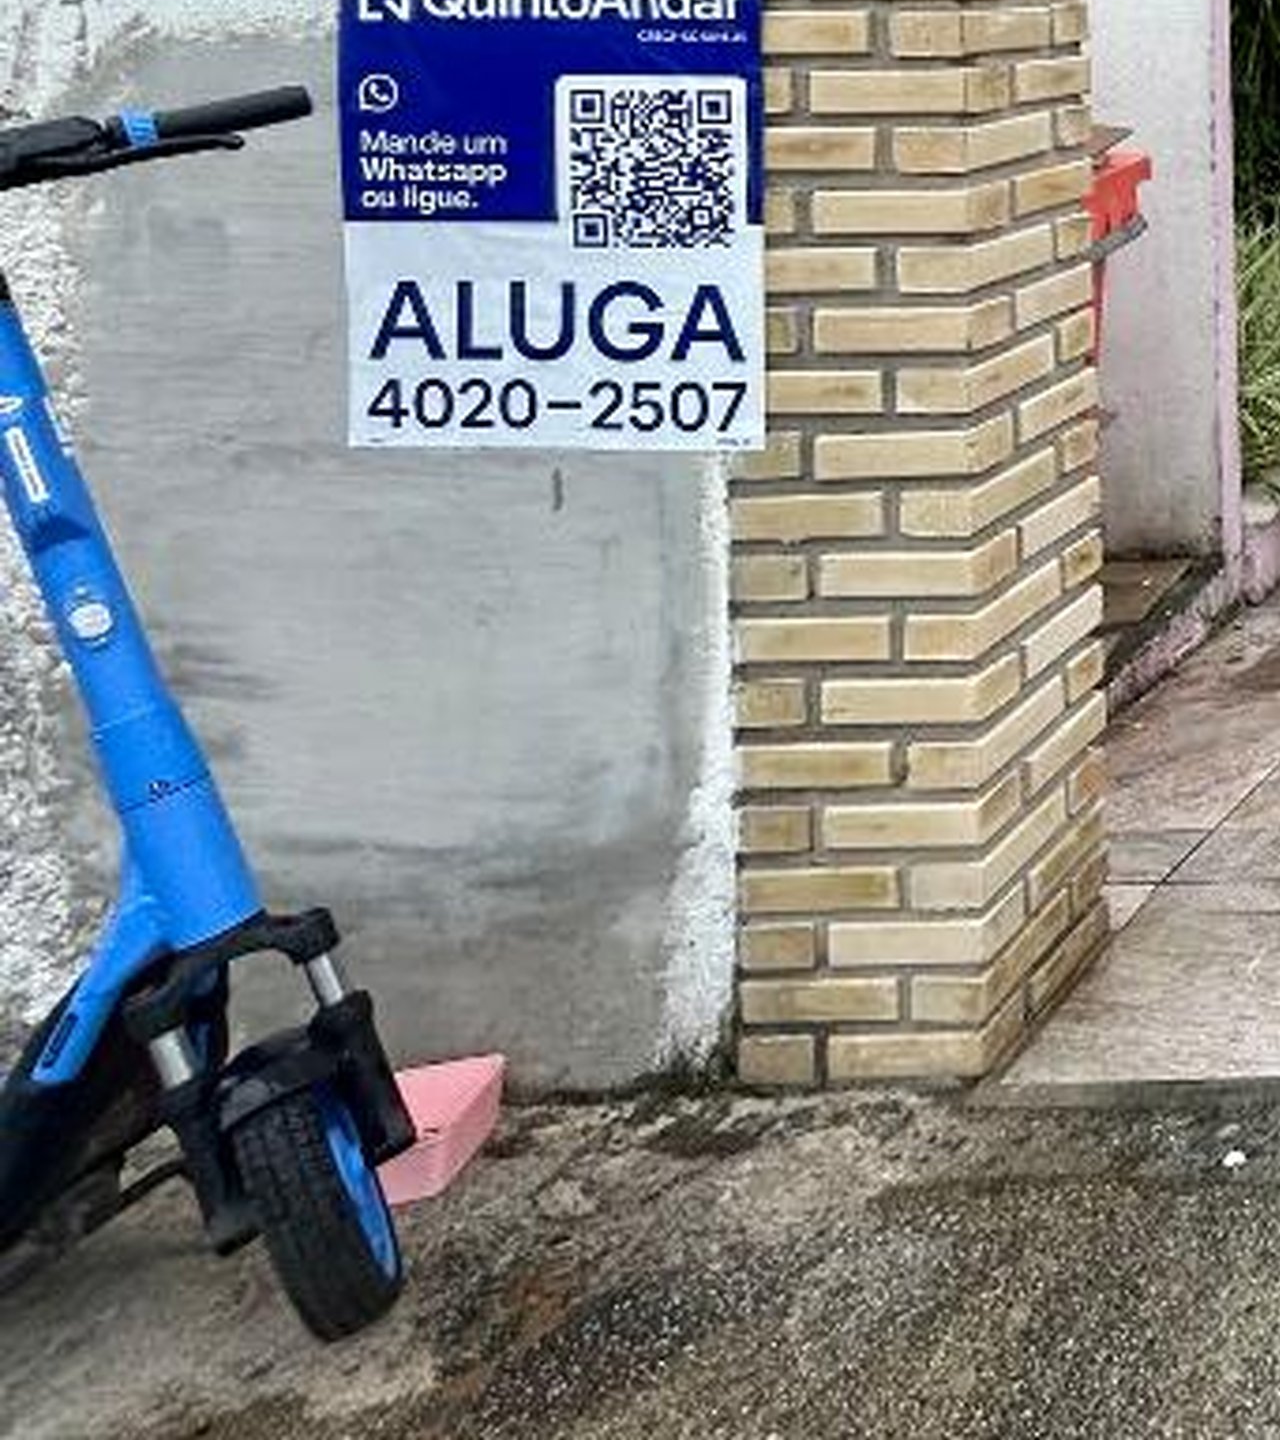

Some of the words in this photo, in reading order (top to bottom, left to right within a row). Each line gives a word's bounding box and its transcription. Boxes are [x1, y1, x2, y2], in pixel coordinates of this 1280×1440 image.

[359, 129, 456, 155] Mande
[463, 133, 508, 155] um
[359, 157, 508, 188] Whatsapp
[361, 190, 397, 208] ou
[402, 183, 480, 215] ligue.
[368, 280, 748, 362] ALUGA
[367, 378, 749, 433] 4020-2507
